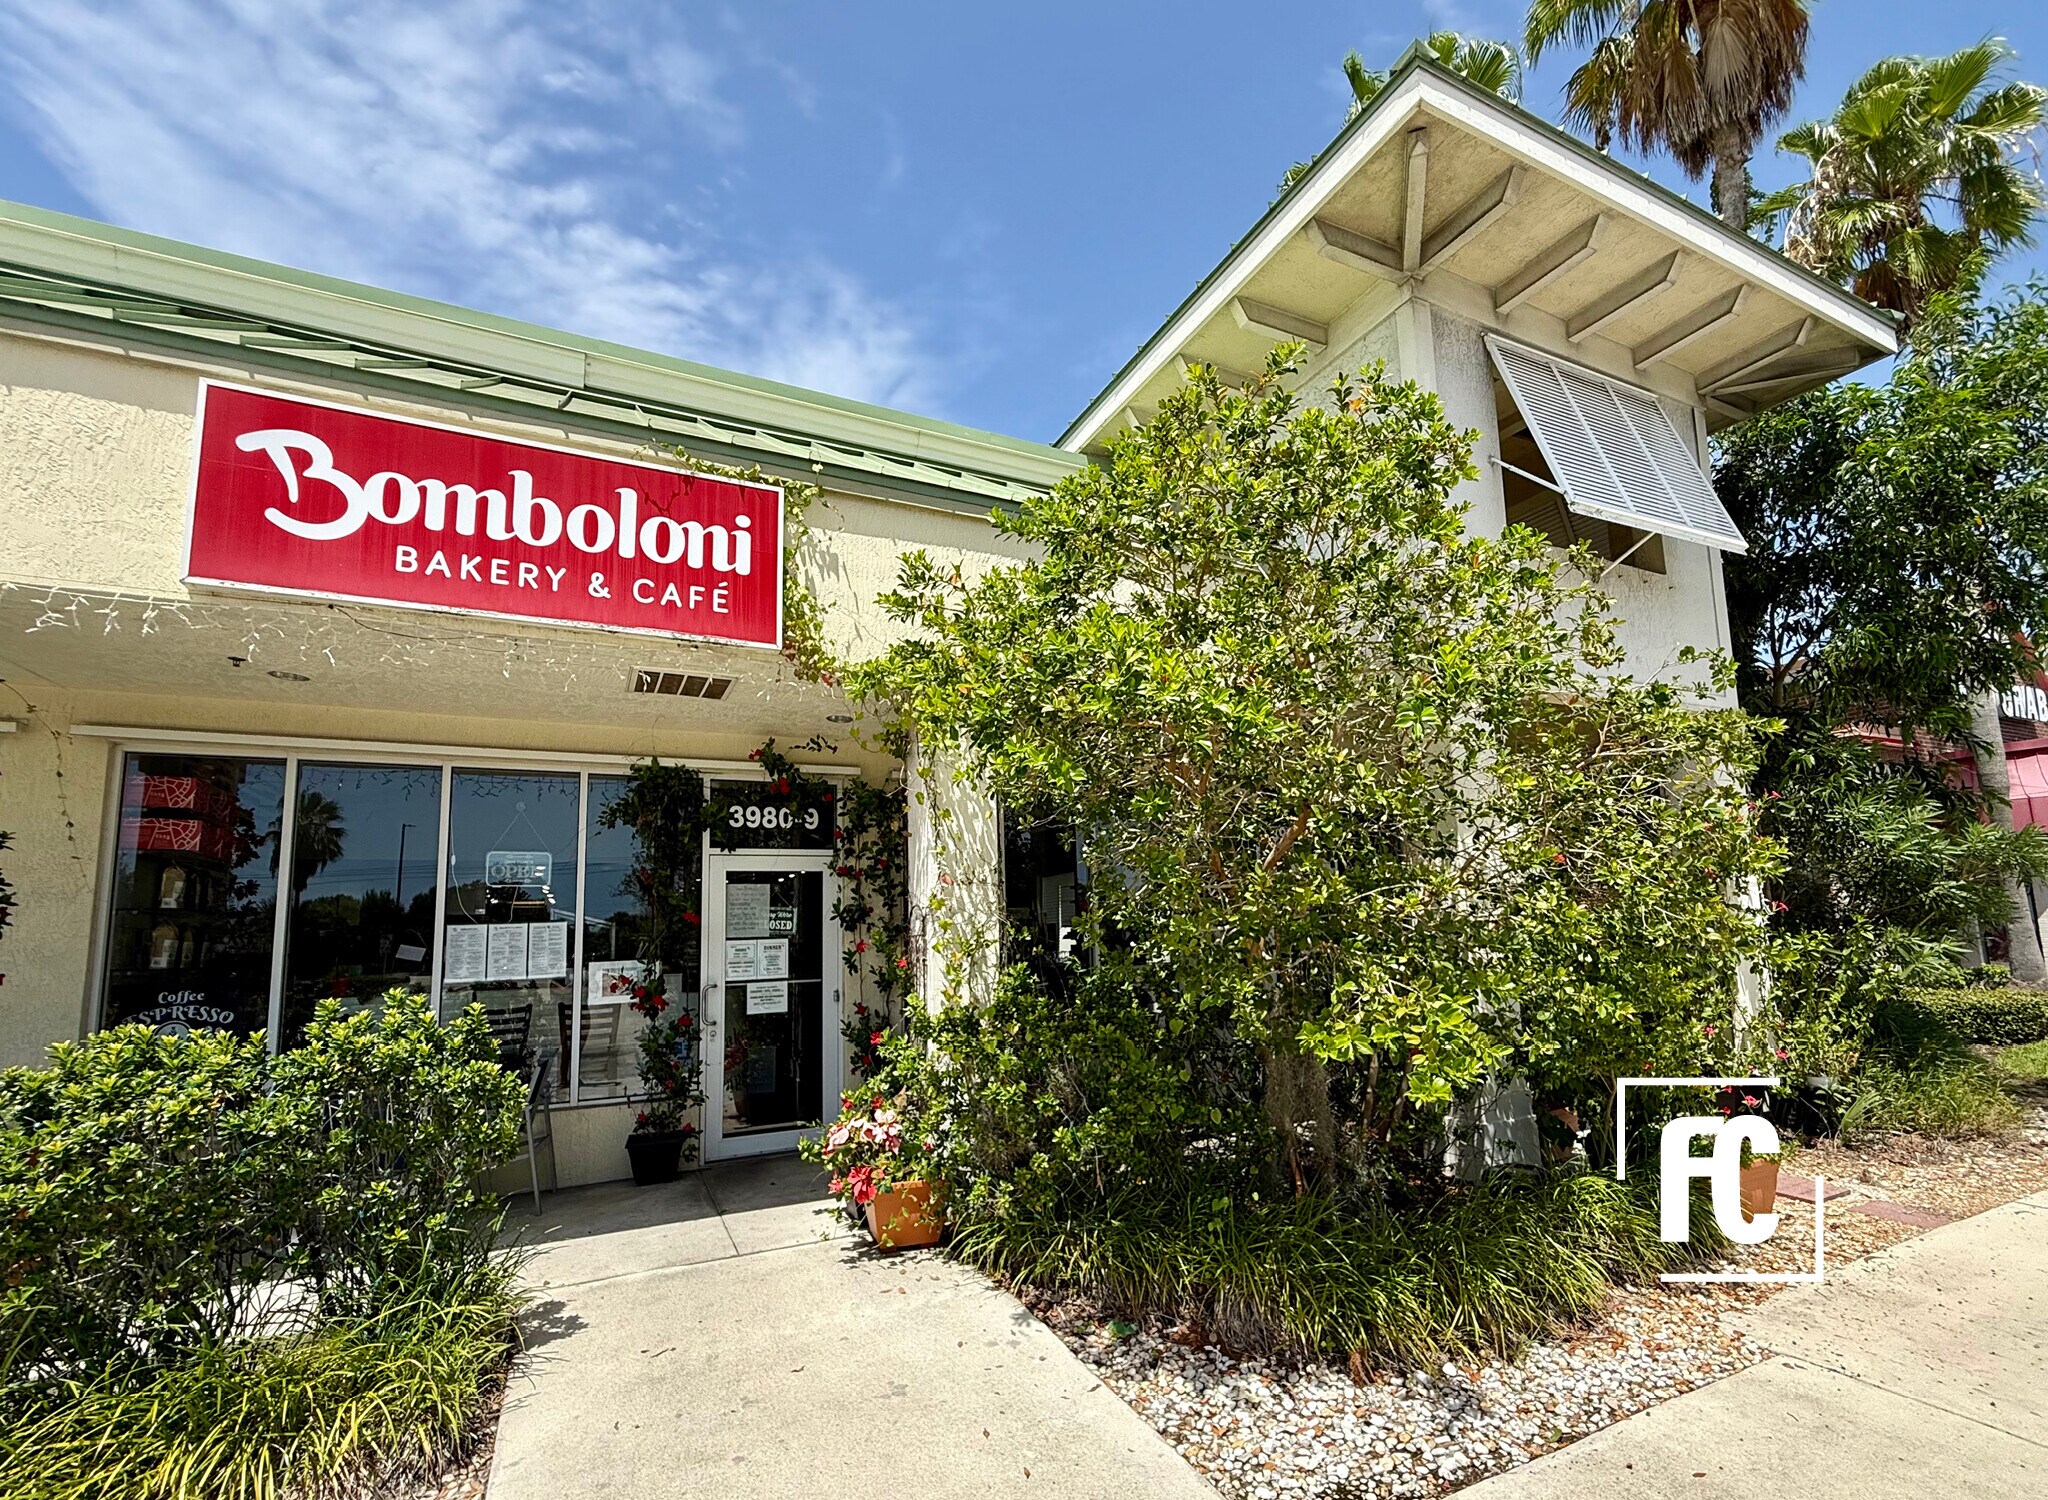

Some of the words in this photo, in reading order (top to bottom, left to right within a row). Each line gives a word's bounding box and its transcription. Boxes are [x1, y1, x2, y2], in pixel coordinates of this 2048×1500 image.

[235, 428, 751, 576] Bomboloni
[395, 545, 568, 592] BAKERY
[588, 572, 611, 598] &
[633, 578, 730, 614] CAFÉ
[769, 920, 793, 930] OSED
[158, 990, 205, 1005] Coffee
